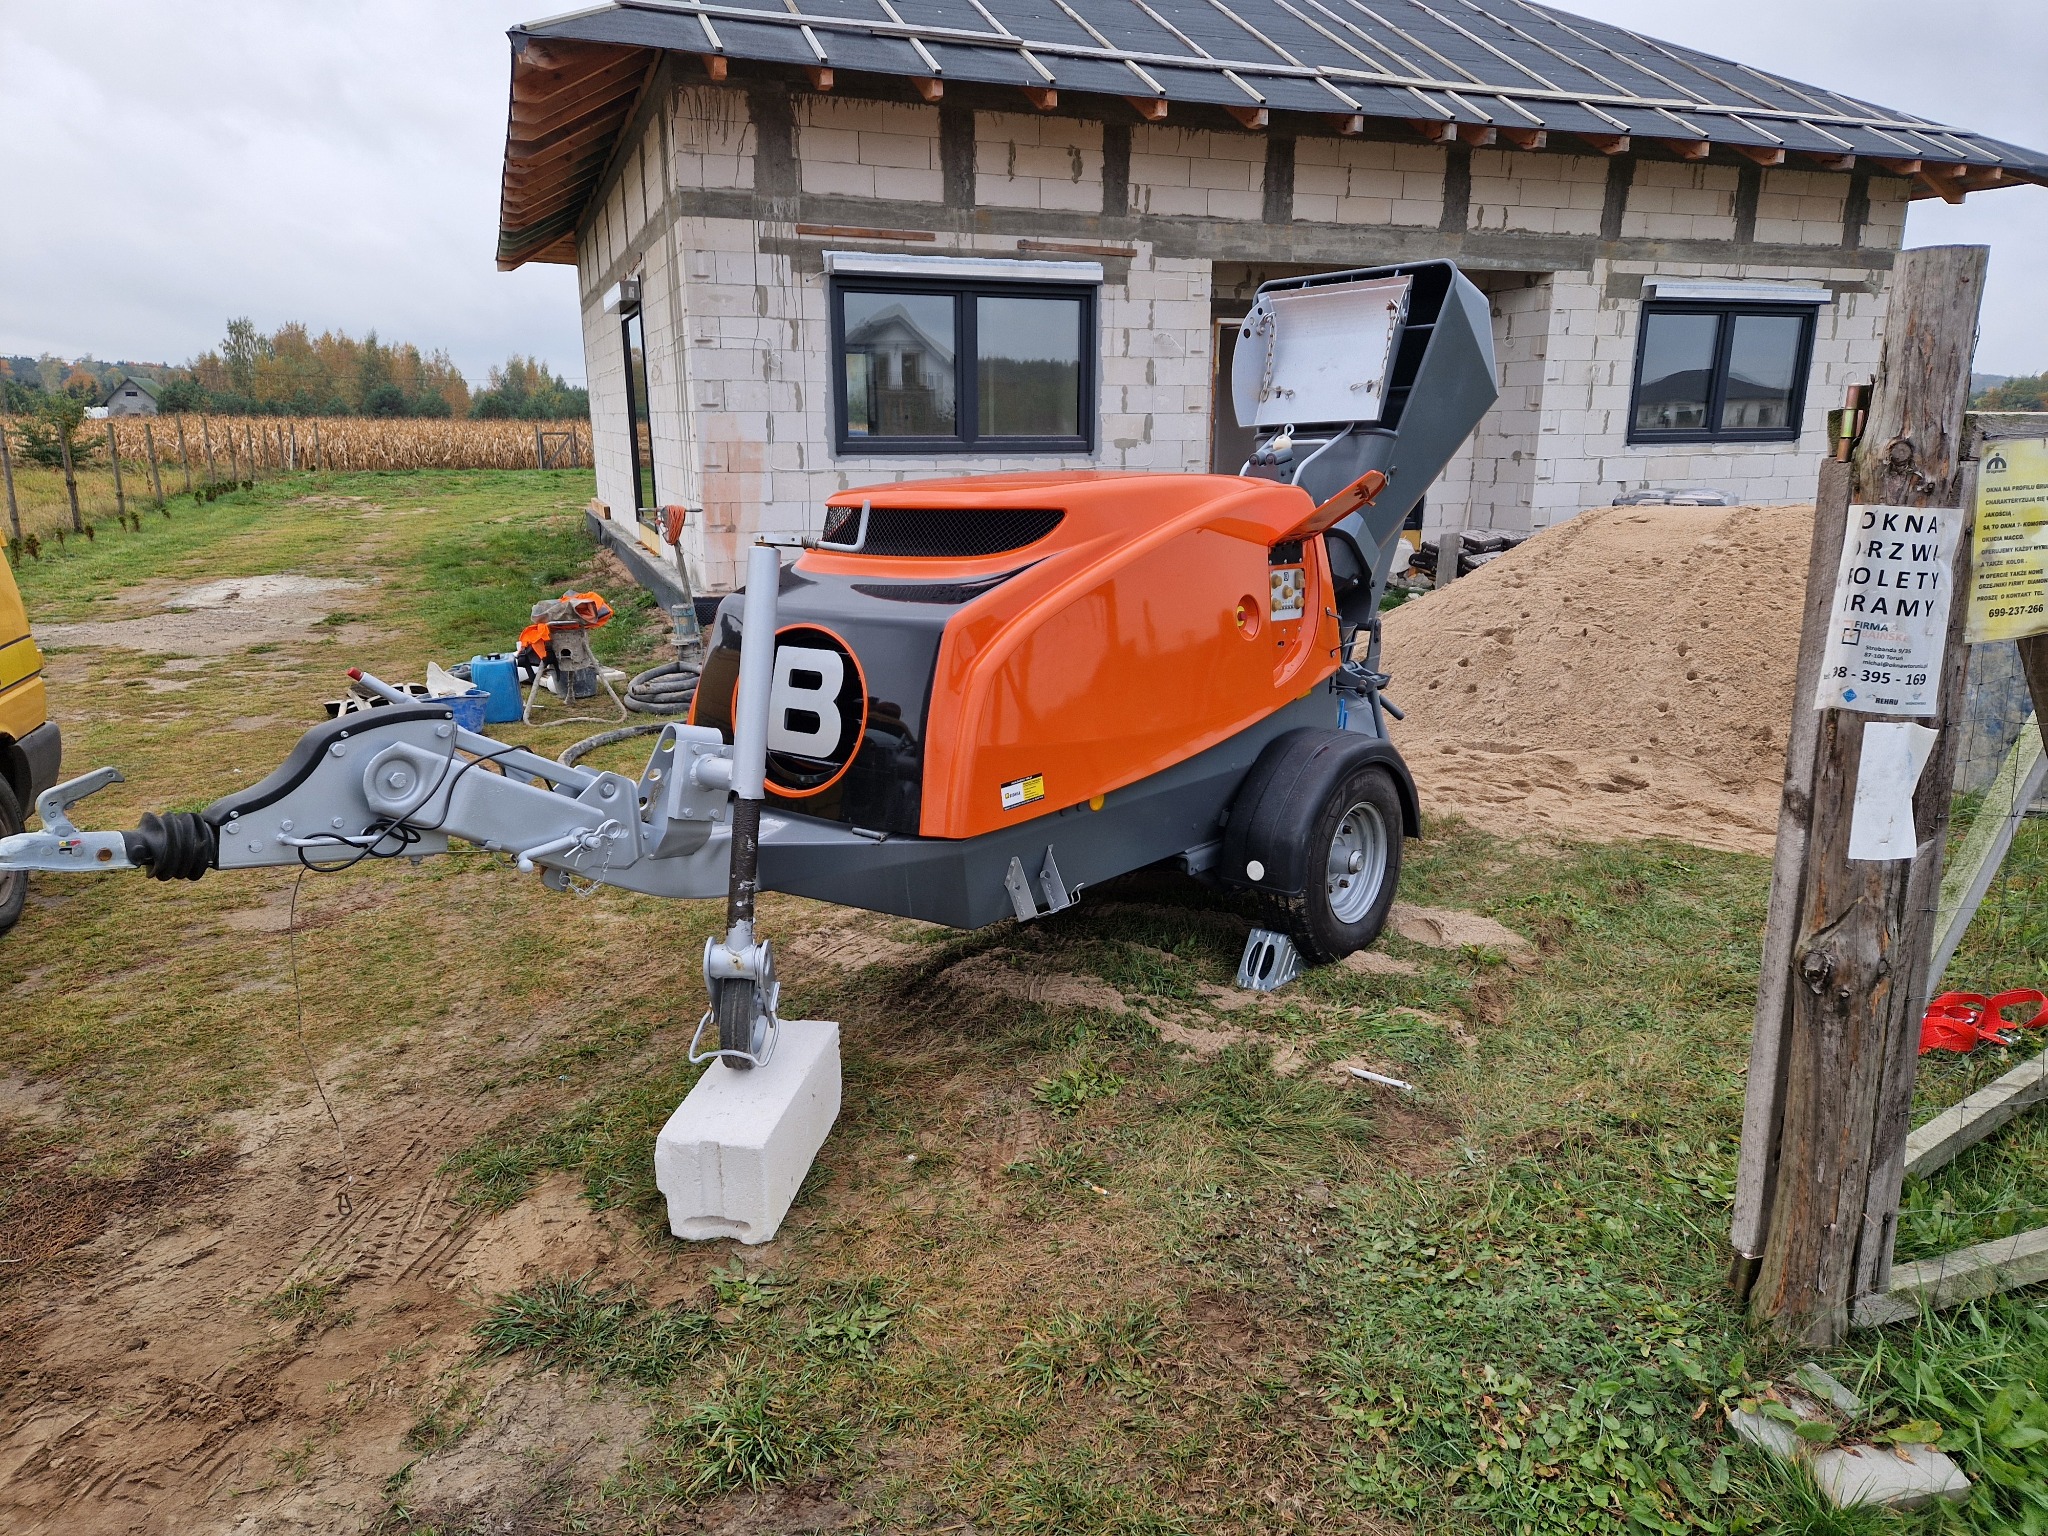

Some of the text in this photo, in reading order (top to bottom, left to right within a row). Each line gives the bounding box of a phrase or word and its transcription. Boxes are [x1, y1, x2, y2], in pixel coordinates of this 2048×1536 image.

[1861, 511, 1937, 534] OKNA
[1856, 540, 1938, 562] RZWI
[2006, 591, 2032, 599] KONTAKT
[1844, 594, 1934, 617] RAMY
[1988, 603, 2044, 618] 699-237-266
[1854, 620, 1889, 632] FIRMA
[1860, 670, 1891, 684] 395
[1905, 673, 1927, 685] 169
[768, 645, 844, 759] B
